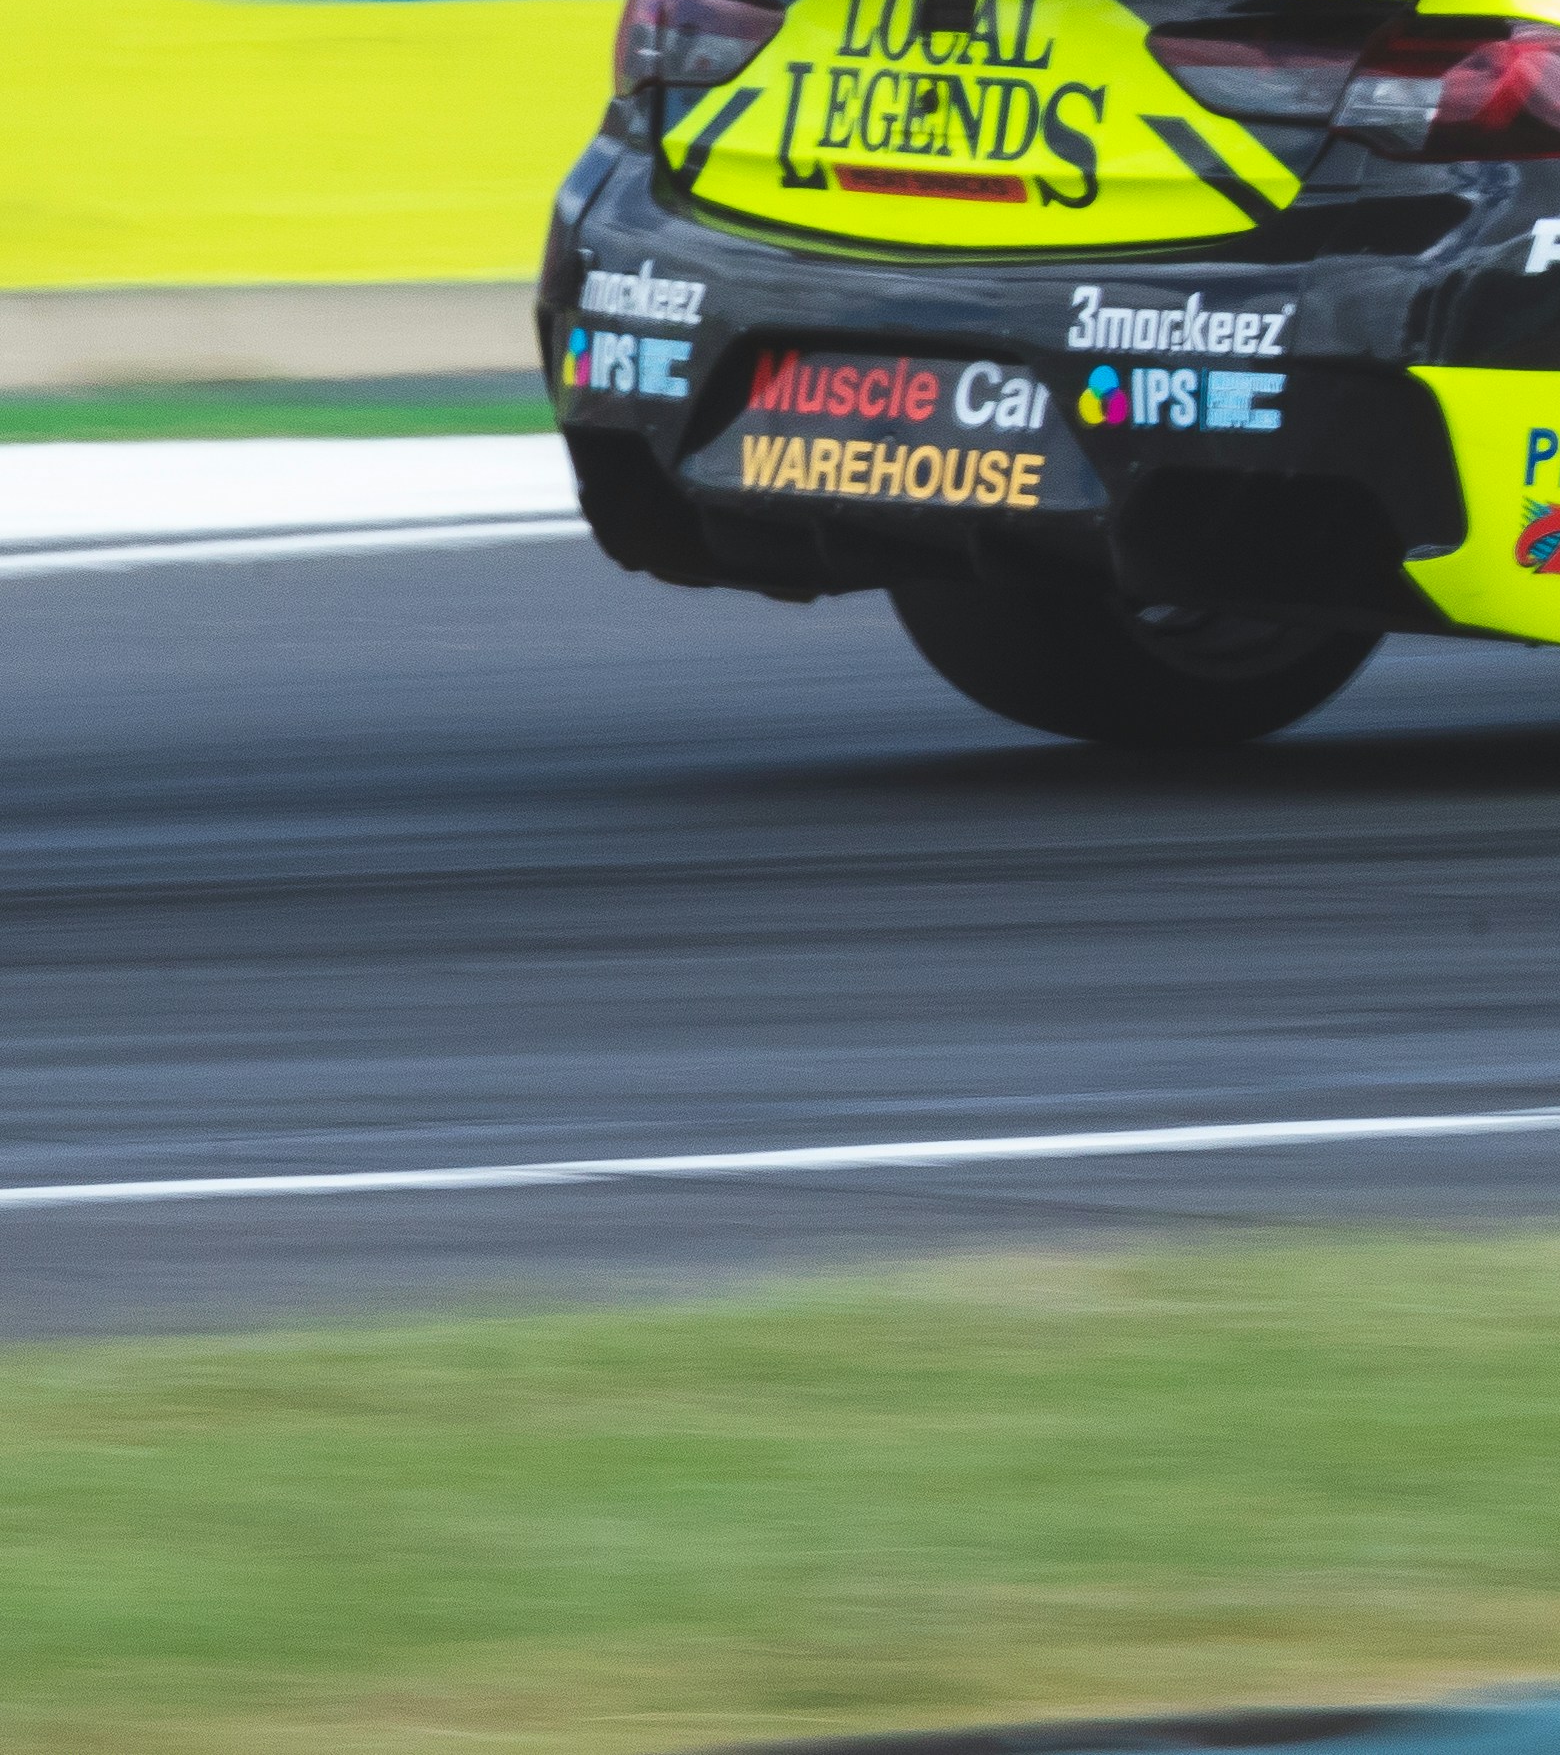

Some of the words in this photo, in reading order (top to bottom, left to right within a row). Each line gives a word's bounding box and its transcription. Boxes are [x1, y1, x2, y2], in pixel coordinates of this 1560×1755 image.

[779, 62, 1106, 209] LEGENDS
[748, 349, 940, 424] Muscle
[955, 360, 1051, 431] Car
[1131, 367, 1198, 429] IPS
[741, 434, 1046, 510] WAREHOUSE
